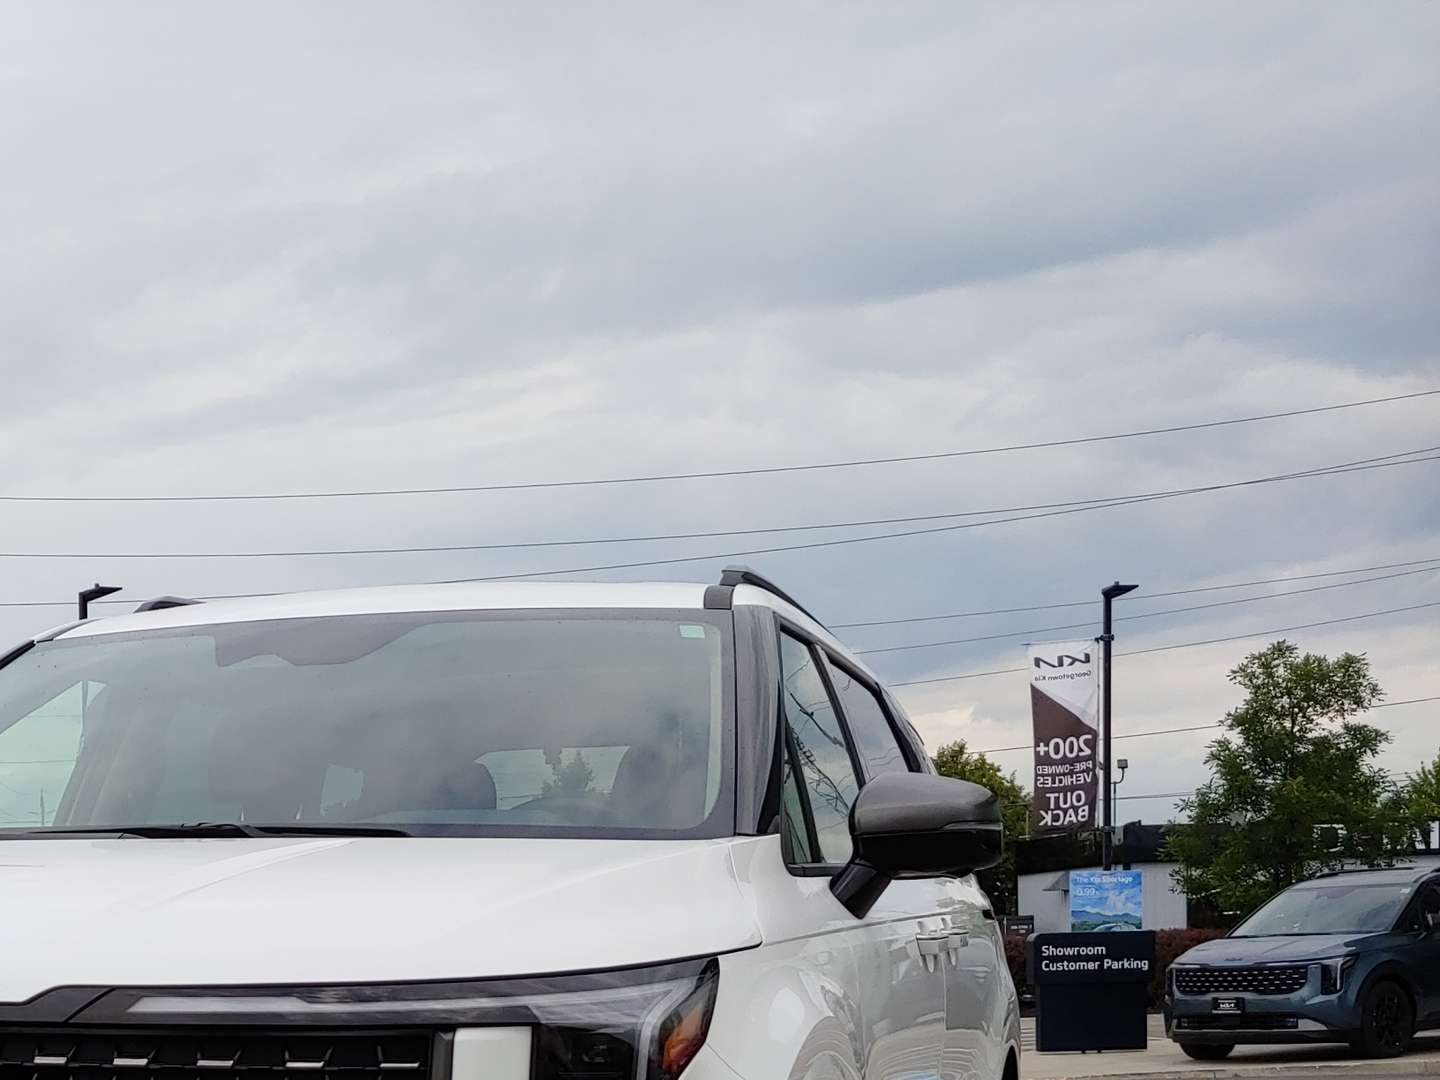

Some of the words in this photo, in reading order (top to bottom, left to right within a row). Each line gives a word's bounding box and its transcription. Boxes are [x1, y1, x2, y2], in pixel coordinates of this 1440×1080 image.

[1041, 945, 1106, 957] Showroom
[1041, 960, 1100, 971] Customer
[1104, 958, 1149, 970] Parking
